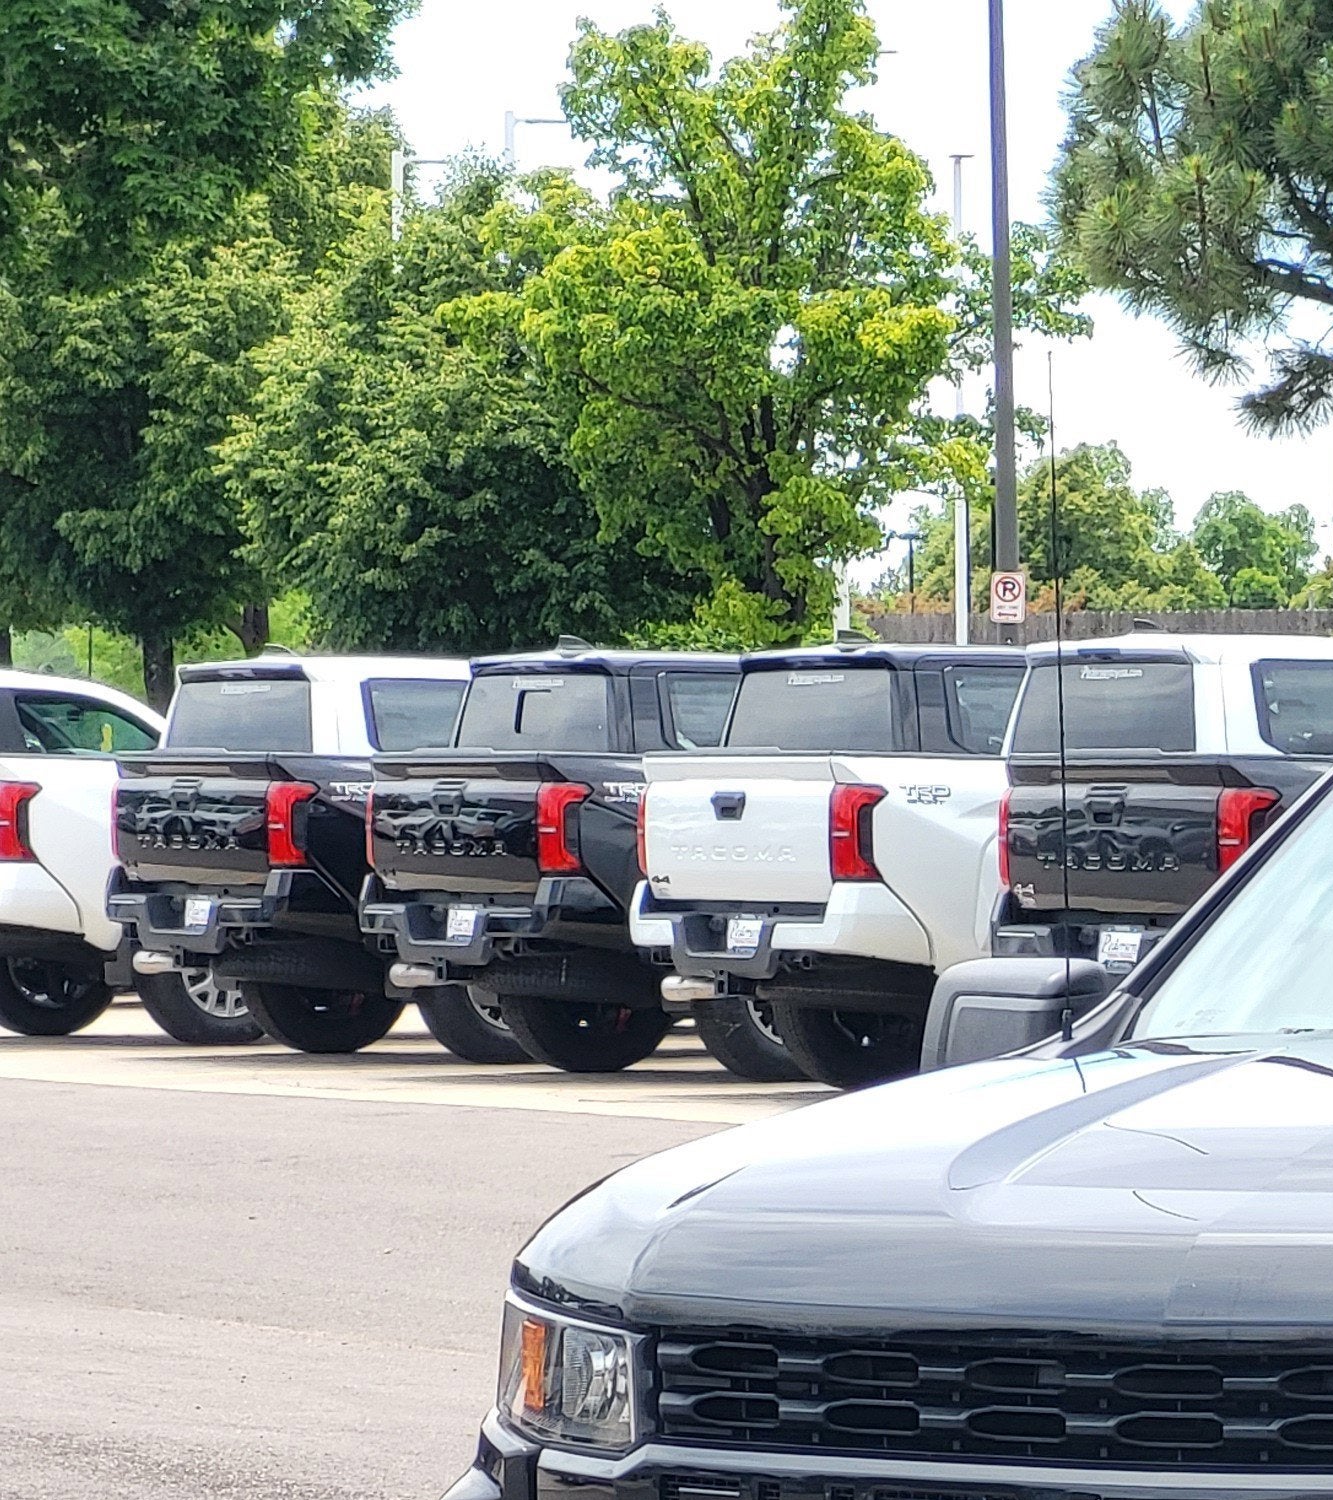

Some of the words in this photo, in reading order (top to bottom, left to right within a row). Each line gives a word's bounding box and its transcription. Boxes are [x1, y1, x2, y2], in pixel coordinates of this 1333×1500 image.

[899, 784, 951, 799] TRD
[137, 834, 240, 850] TACOMA
[395, 839, 508, 857] TACOMA
[670, 844, 797, 862] TACOMA
[1036, 852, 1181, 871] TACOMA
